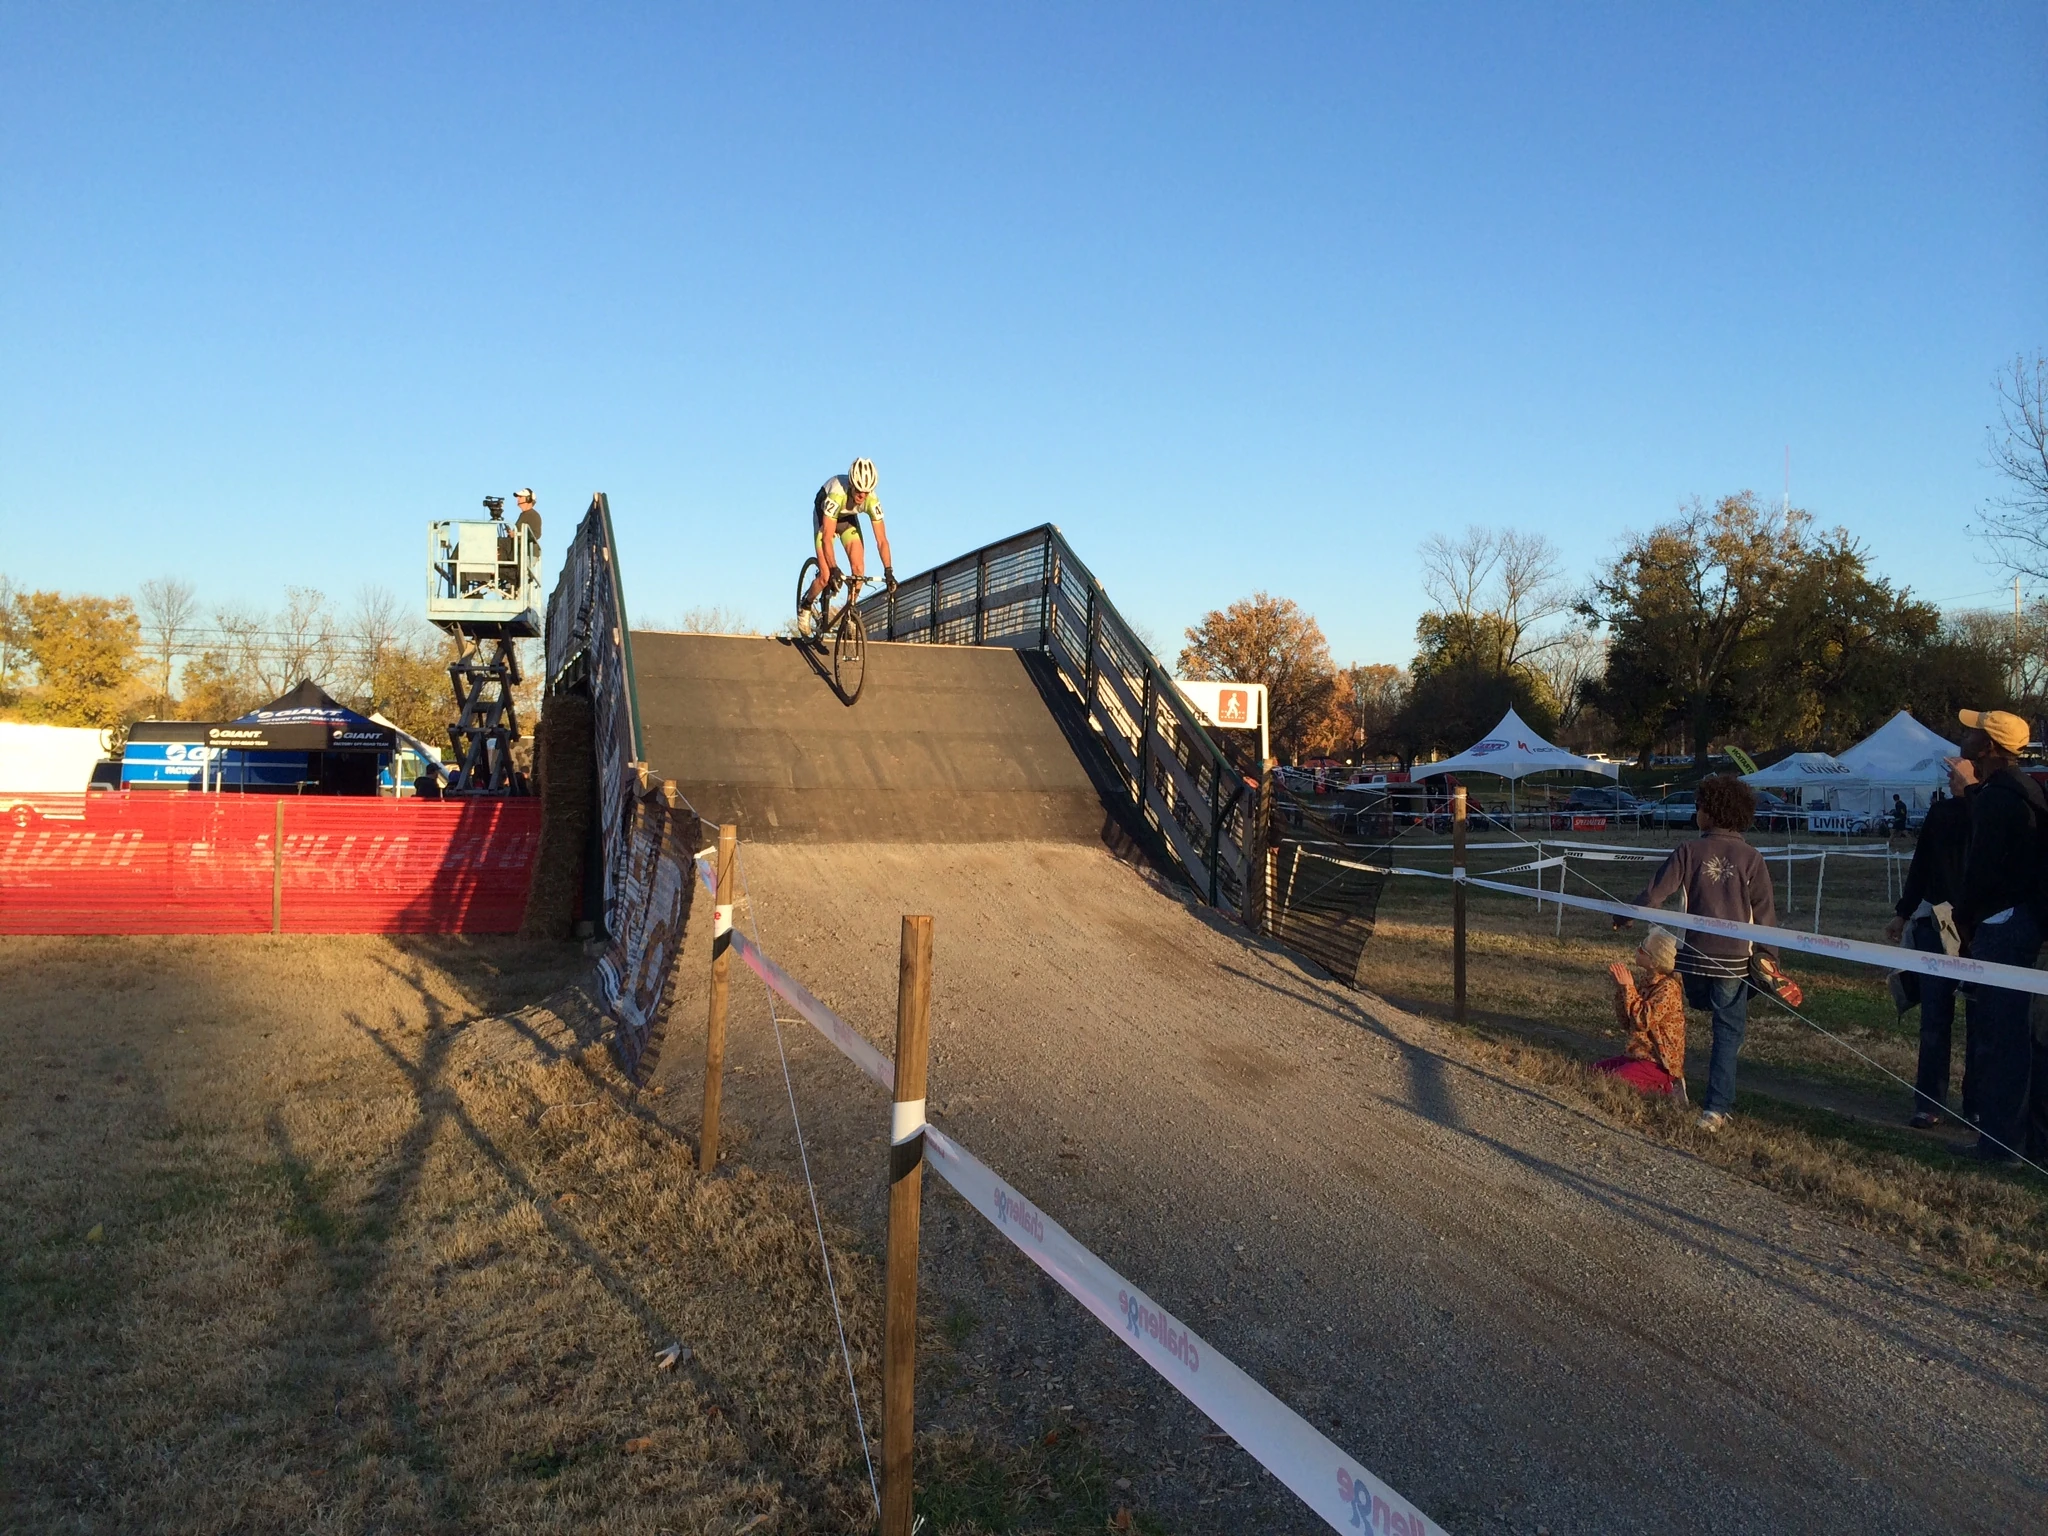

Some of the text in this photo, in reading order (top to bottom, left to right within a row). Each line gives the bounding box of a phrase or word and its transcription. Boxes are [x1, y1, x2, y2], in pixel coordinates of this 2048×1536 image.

[275, 708, 343, 718] GIANT
[220, 730, 262, 738] GIANT
[1800, 765, 1850, 774] LIVING
[1813, 817, 1853, 830] LIVING
